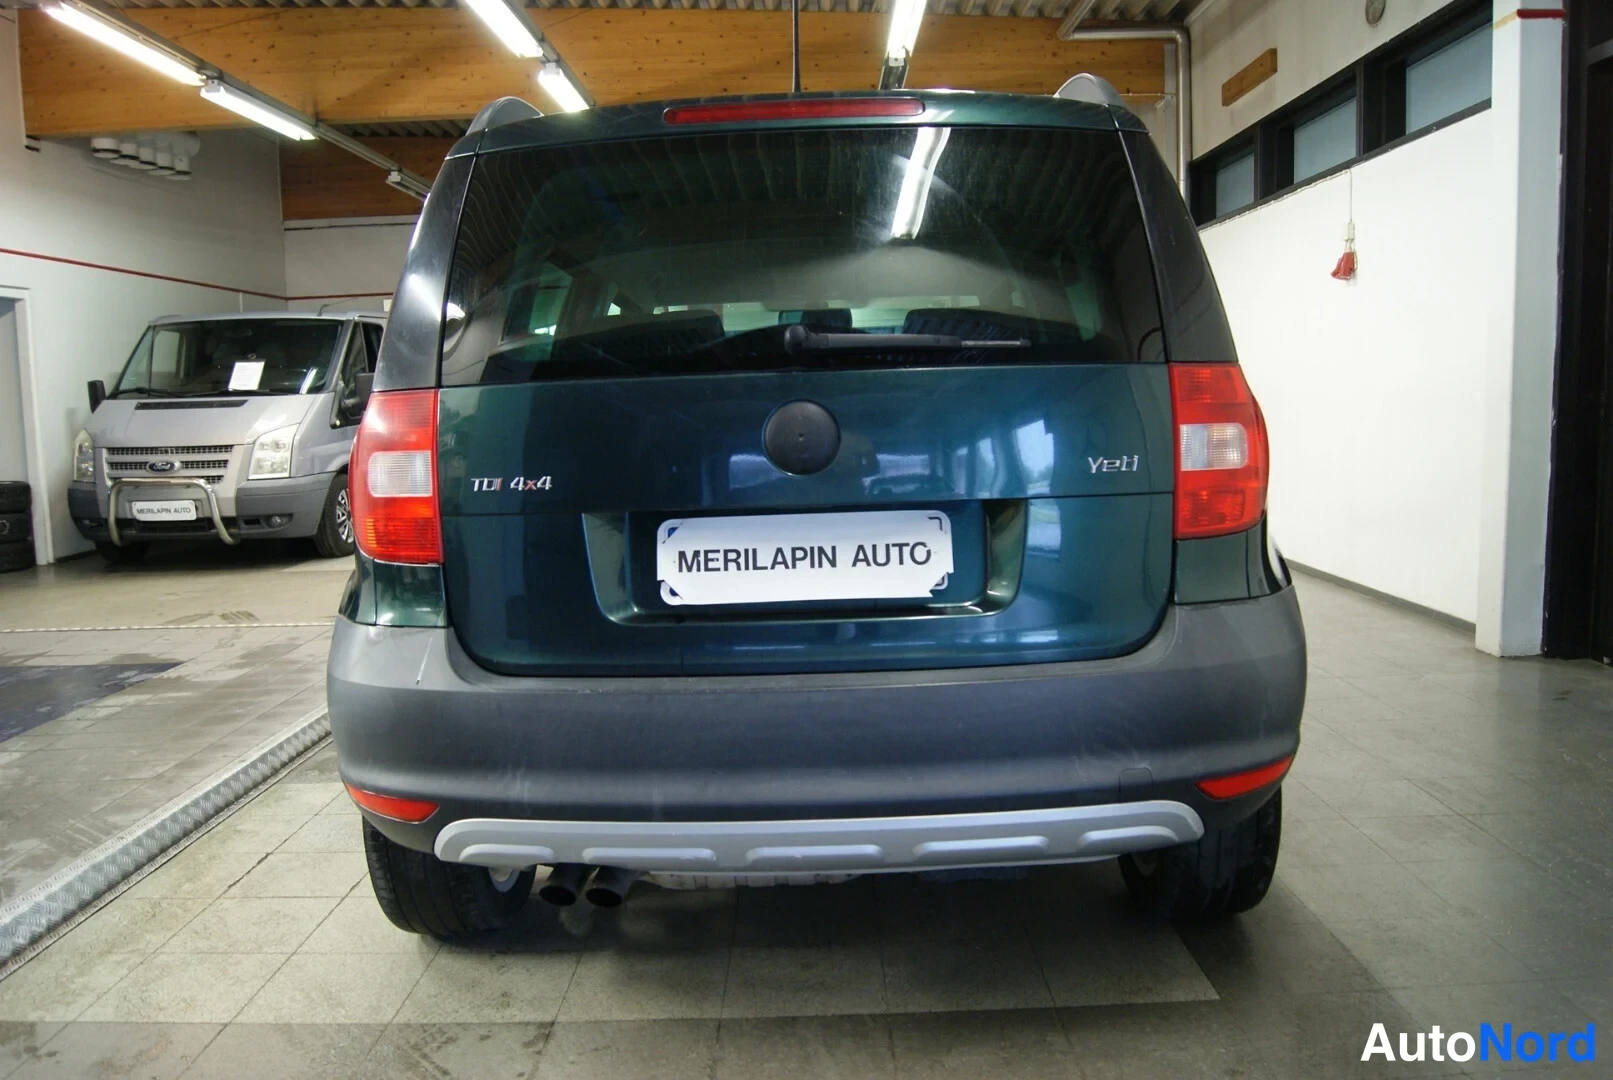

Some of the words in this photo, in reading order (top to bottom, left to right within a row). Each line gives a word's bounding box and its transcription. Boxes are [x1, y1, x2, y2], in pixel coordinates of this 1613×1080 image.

[153, 462, 171, 470] Ford
[1087, 455, 1139, 473] Yeti
[470, 477, 503, 492] TDI
[510, 476, 552, 491] 4x4
[677, 545, 837, 573] MERILAPIN
[851, 541, 932, 567] AUTO
